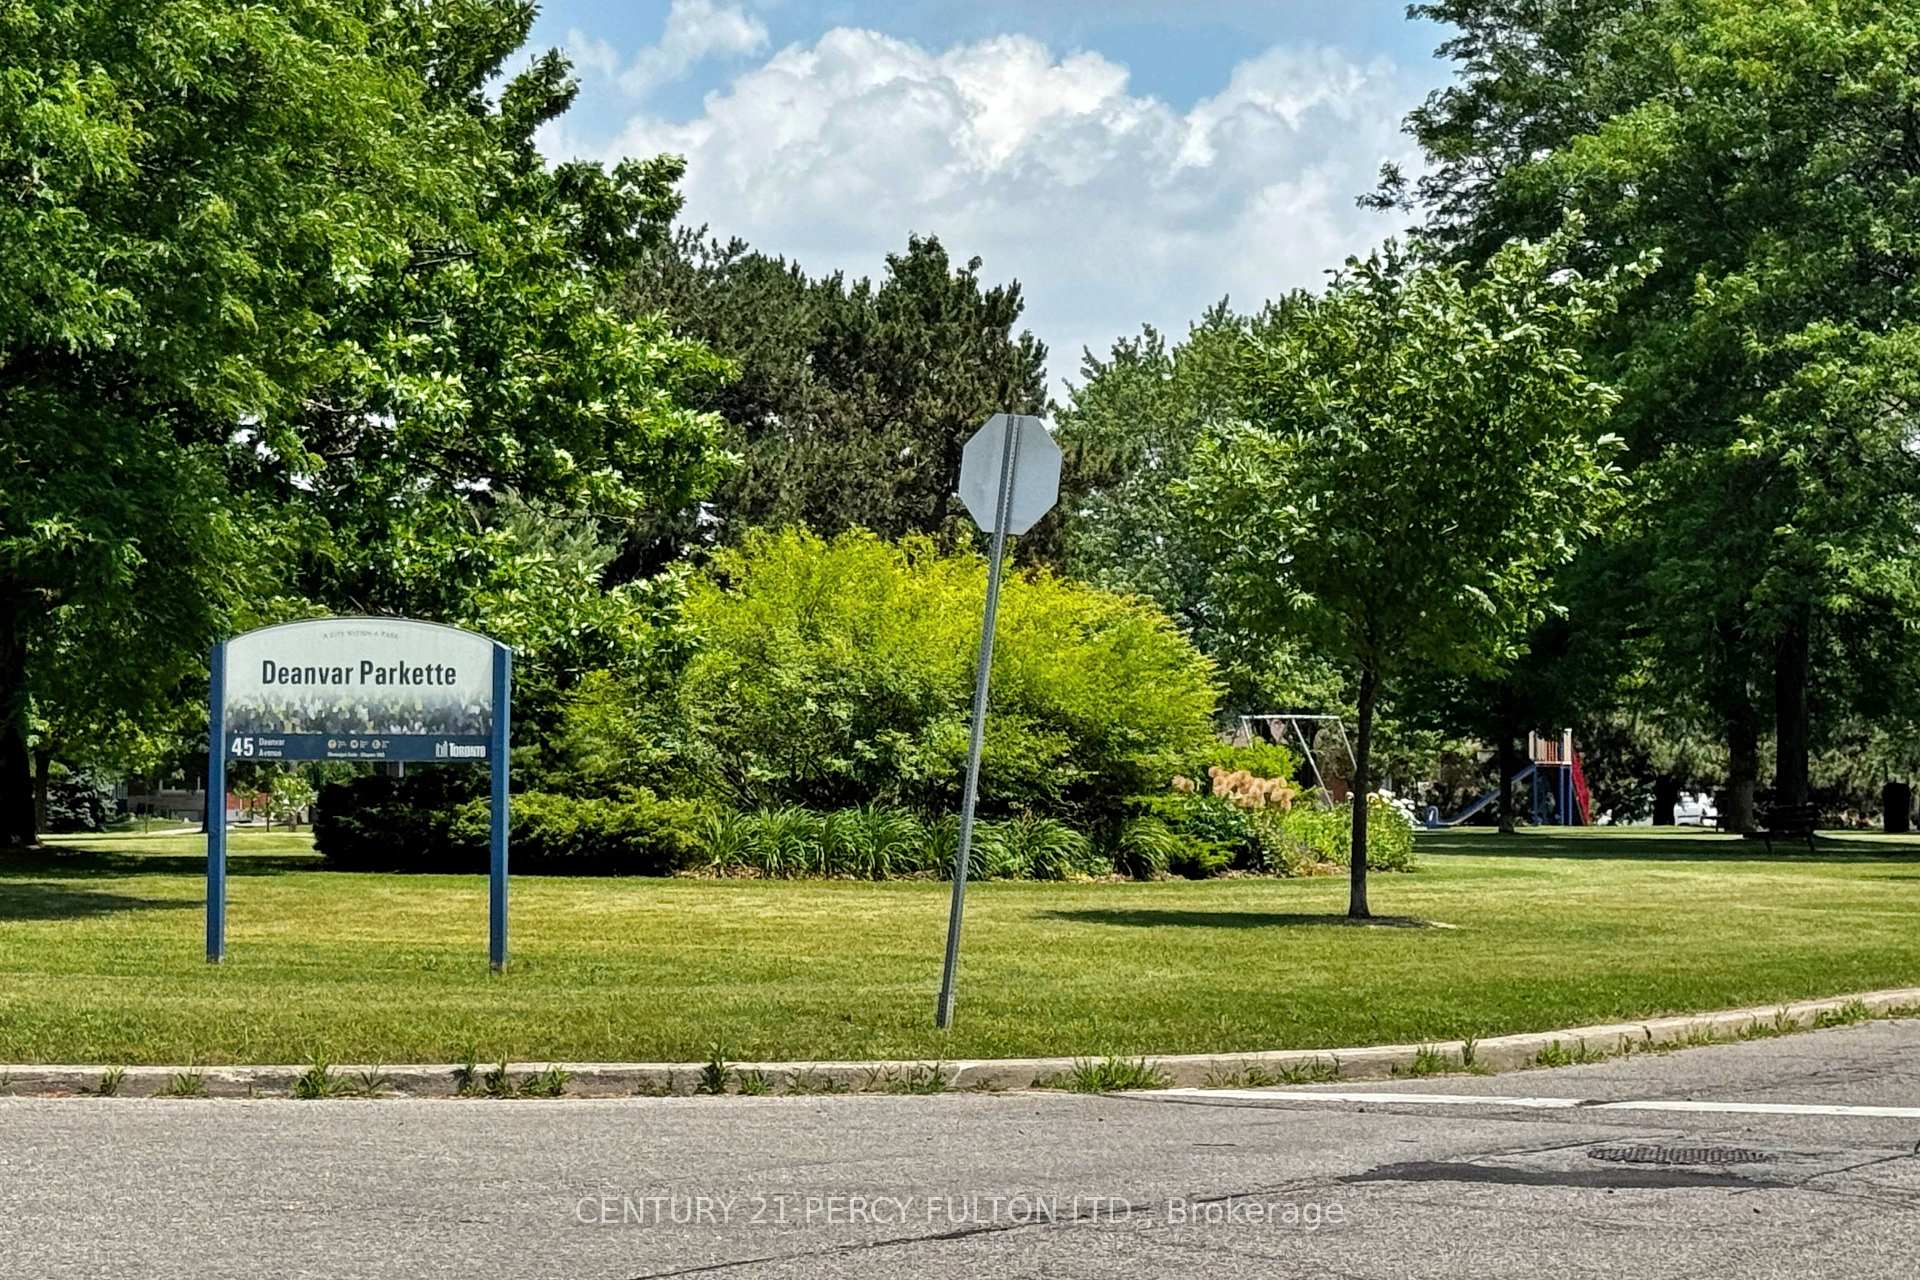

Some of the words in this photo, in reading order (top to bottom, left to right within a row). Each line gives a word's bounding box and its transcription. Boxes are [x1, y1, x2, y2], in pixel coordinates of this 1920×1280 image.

[262, 660, 354, 686] Deanvar
[360, 660, 457, 686] Parkette
[231, 737, 254, 757] 45
